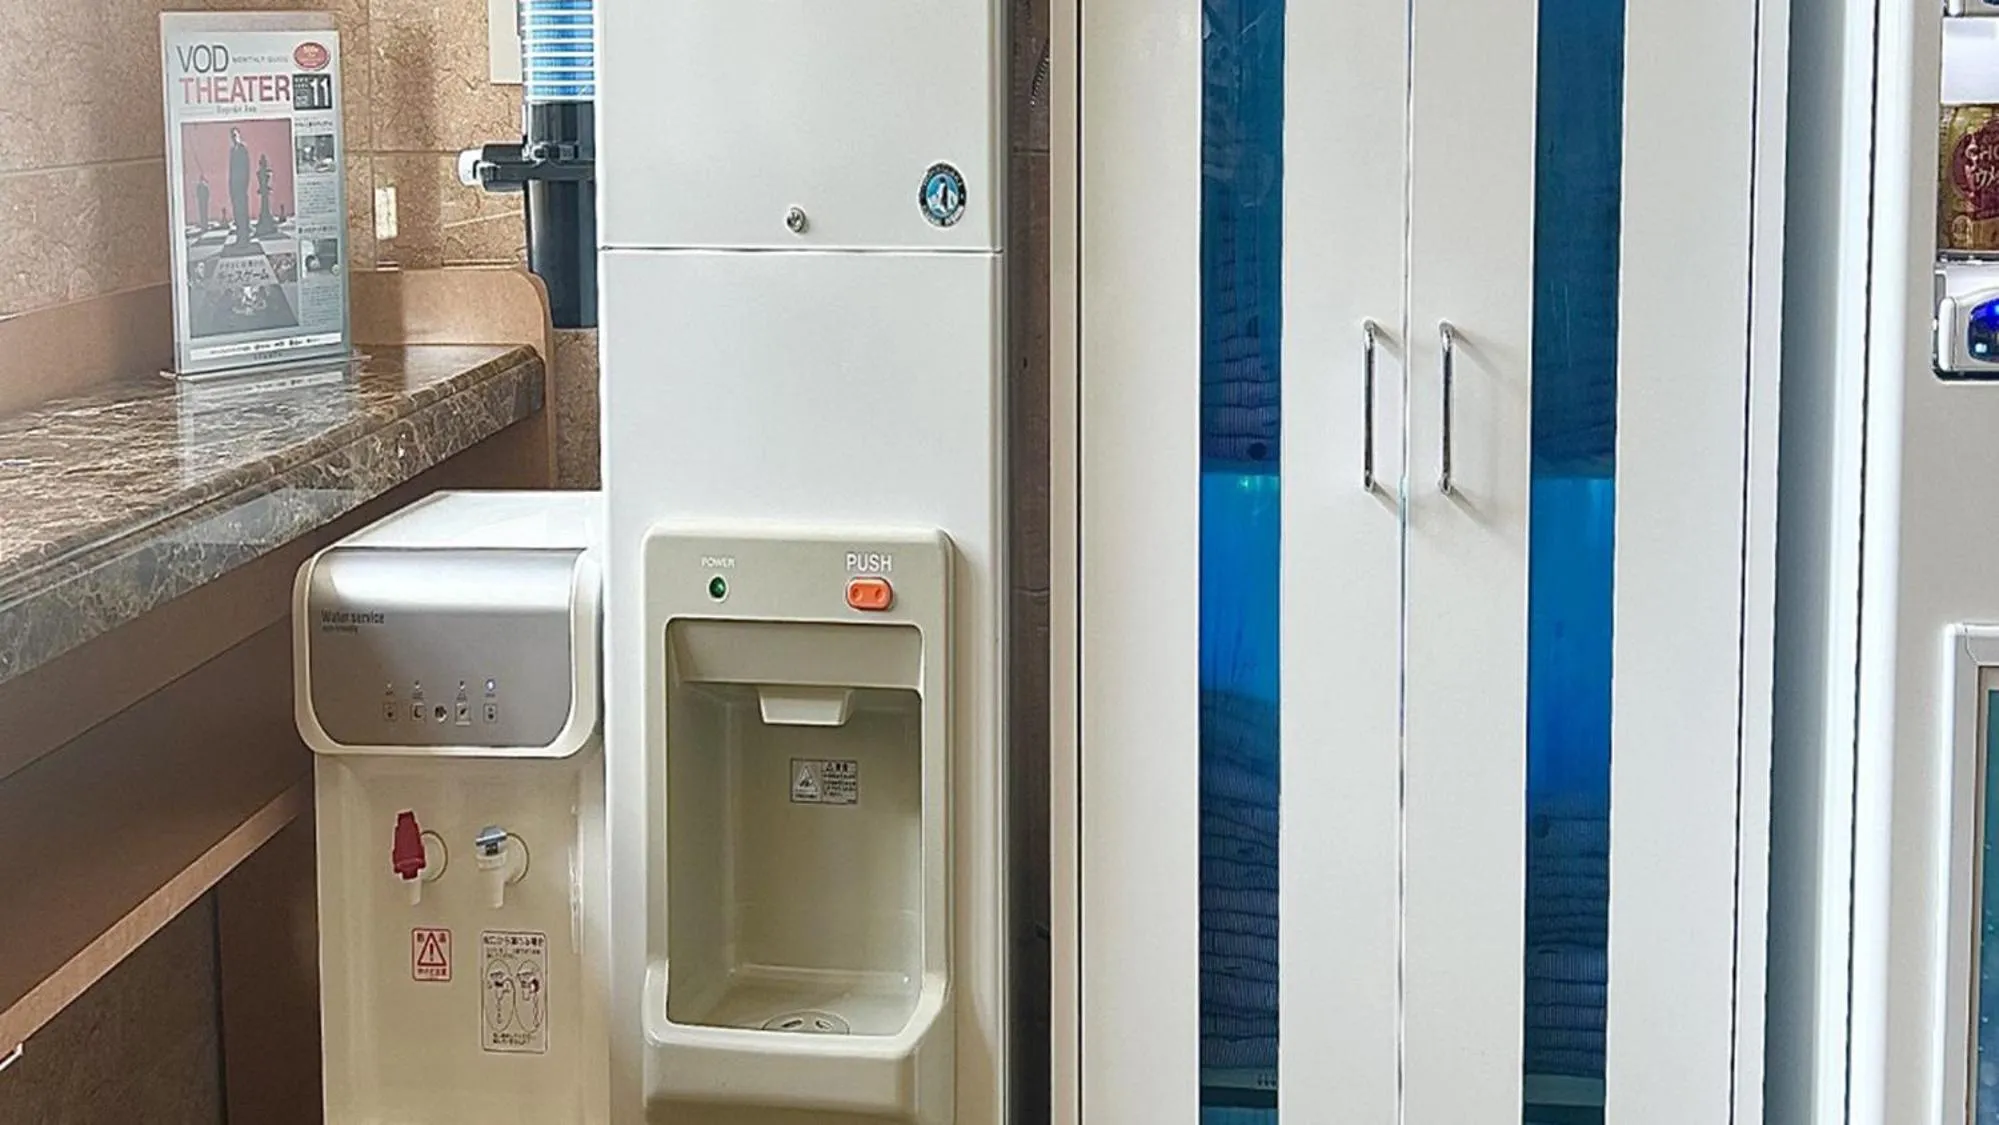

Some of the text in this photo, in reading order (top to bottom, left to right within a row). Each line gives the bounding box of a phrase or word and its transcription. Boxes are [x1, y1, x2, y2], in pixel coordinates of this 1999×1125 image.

[176, 44, 229, 73] VOD
[178, 74, 290, 104] THEATER
[310, 77, 329, 107] 11
[701, 556, 735, 569] POWER
[846, 553, 893, 572] PUSH
[321, 608, 385, 625] Water service
